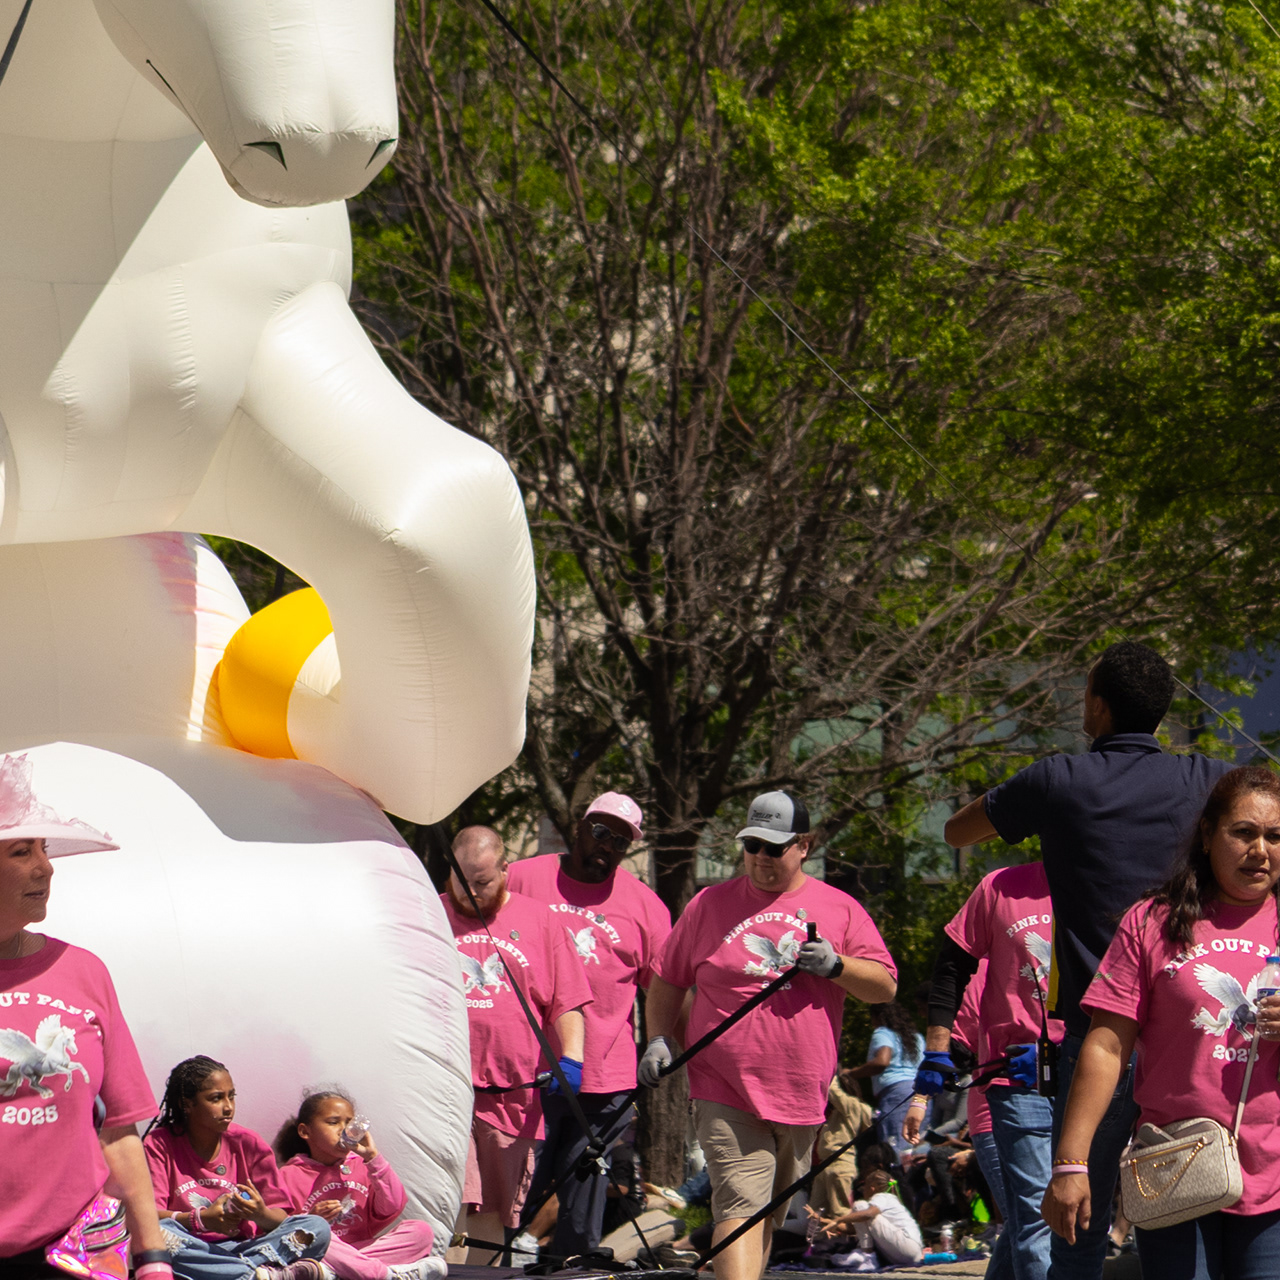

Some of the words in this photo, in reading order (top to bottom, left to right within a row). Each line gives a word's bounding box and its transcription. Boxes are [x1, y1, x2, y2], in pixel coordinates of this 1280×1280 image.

[559, 903, 586, 916] OUT
[723, 917, 753, 945] PINK
[755, 912, 784, 924] OUT
[1007, 916, 1040, 938] PINK
[463, 934, 489, 944] OUT
[490, 937, 530, 968] PARTY!
[1164, 943, 1209, 978] PINK
[1212, 938, 1253, 954] OUT
[2, 1105, 59, 1125] 2025
[198, 1178, 219, 1186] OUT
[302, 1191, 322, 1213] PINK
[322, 1182, 341, 1193] OUT
